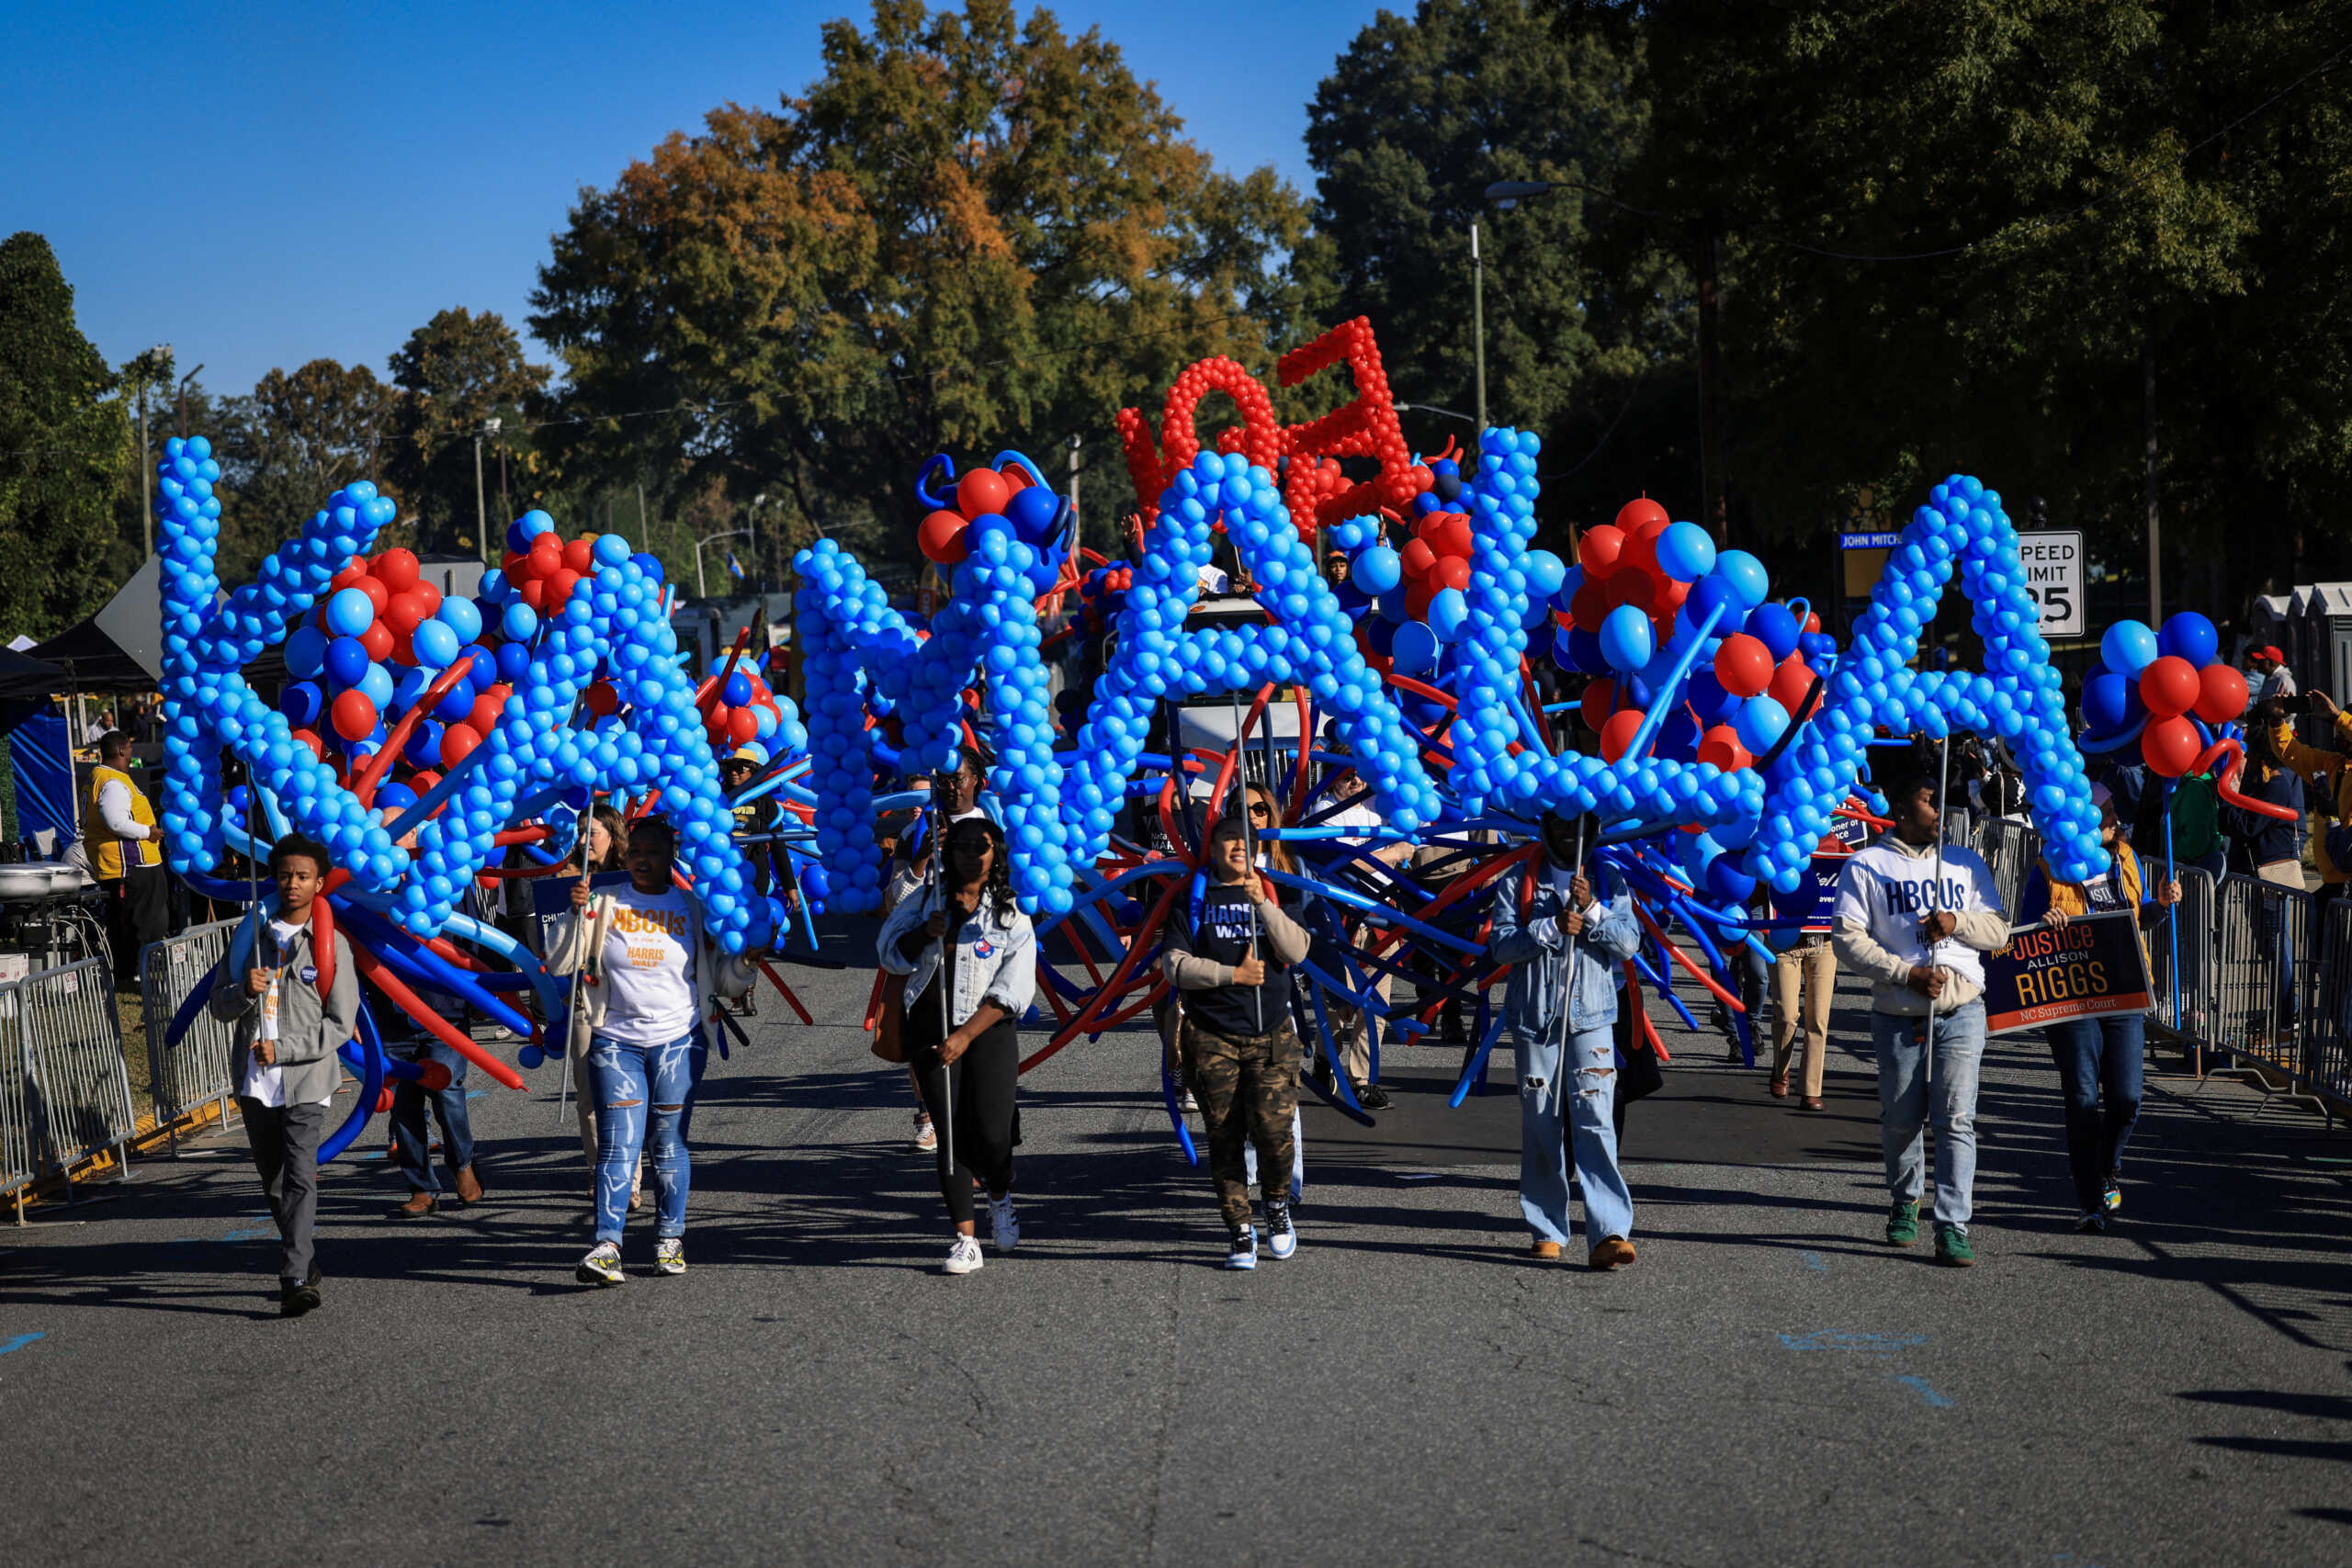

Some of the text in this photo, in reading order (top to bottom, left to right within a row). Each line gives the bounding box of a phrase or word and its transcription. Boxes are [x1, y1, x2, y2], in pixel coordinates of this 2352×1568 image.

[1843, 536, 1869, 547] JOHN
[2020, 545, 2075, 561] PEED
[2028, 566, 2067, 581] IMIT
[627, 946, 665, 962] HARRIS
[2027, 951, 2089, 971] ALLISON
[631, 960, 659, 968] WALZ
[2015, 961, 2109, 1007] RIGGS
[2020, 998, 2117, 1021] NC Supreme Court
